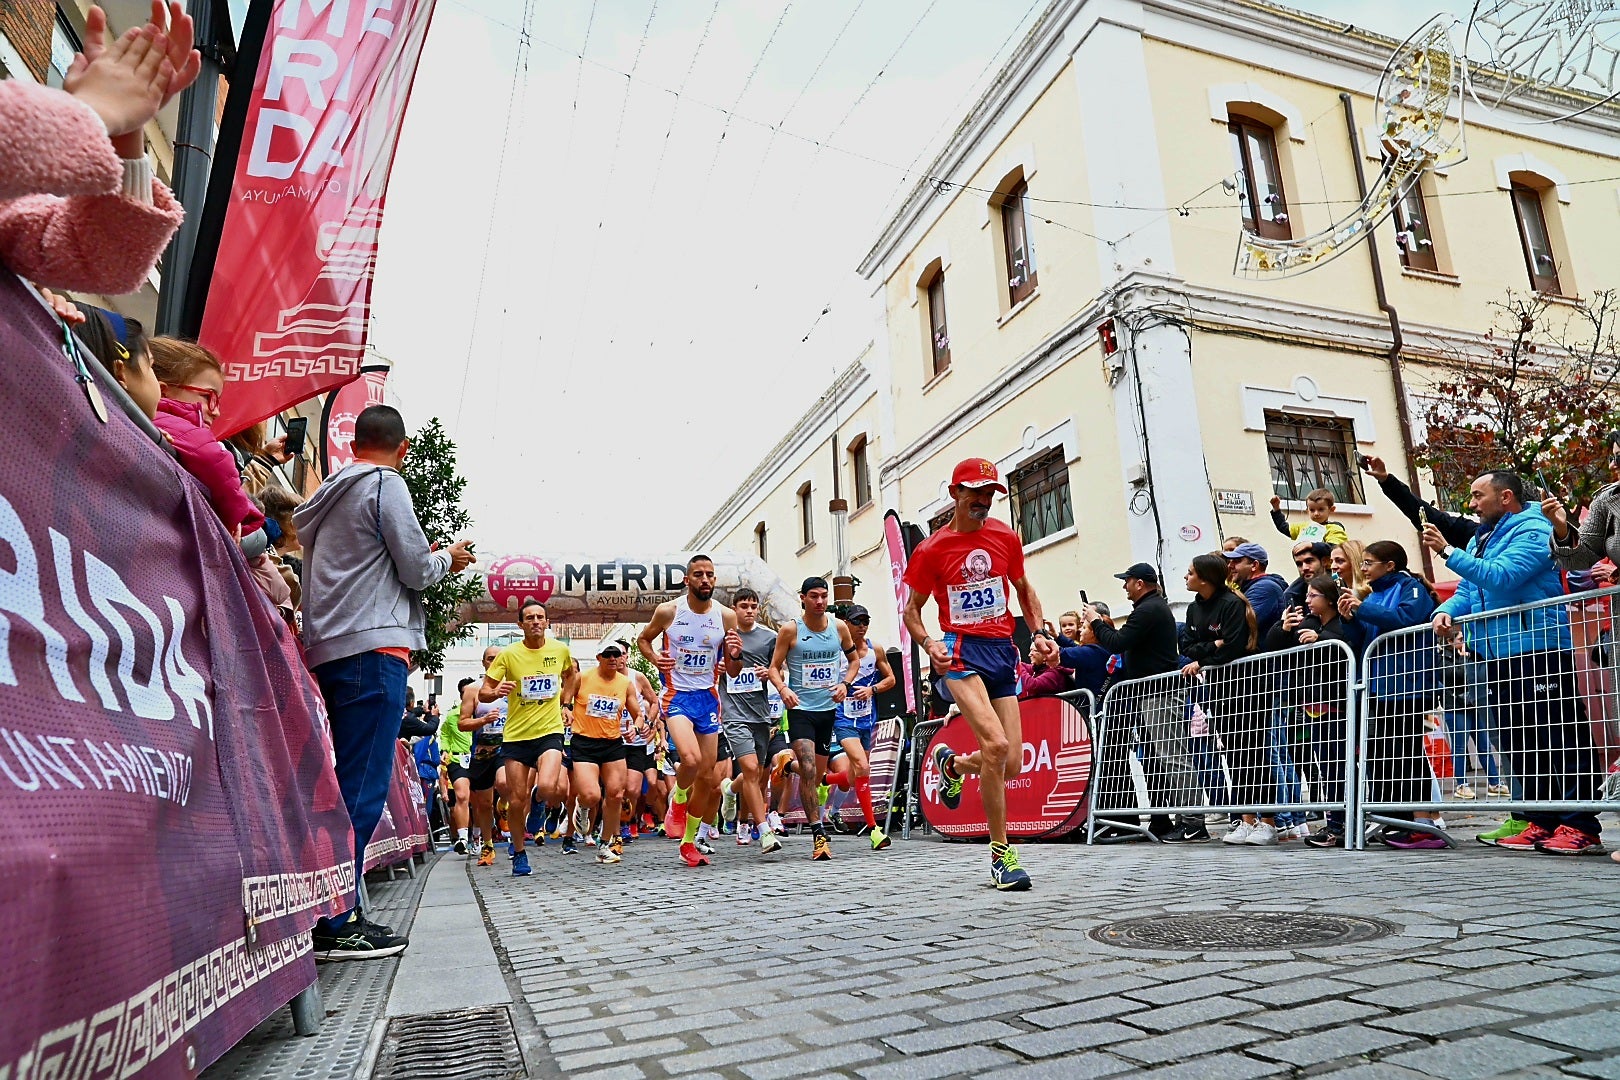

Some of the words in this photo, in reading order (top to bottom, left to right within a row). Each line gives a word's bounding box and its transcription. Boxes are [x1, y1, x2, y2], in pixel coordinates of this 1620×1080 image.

[246, 107, 349, 180] DA
[960, 587, 995, 609] 233
[683, 653, 707, 666] 216
[734, 671, 754, 685] 200
[810, 667, 832, 680] 463
[529, 678, 552, 691] 278
[593, 699, 614, 711] 434
[850, 700, 868, 711] 182
[0, 727, 192, 807] UNTAMIENTO
